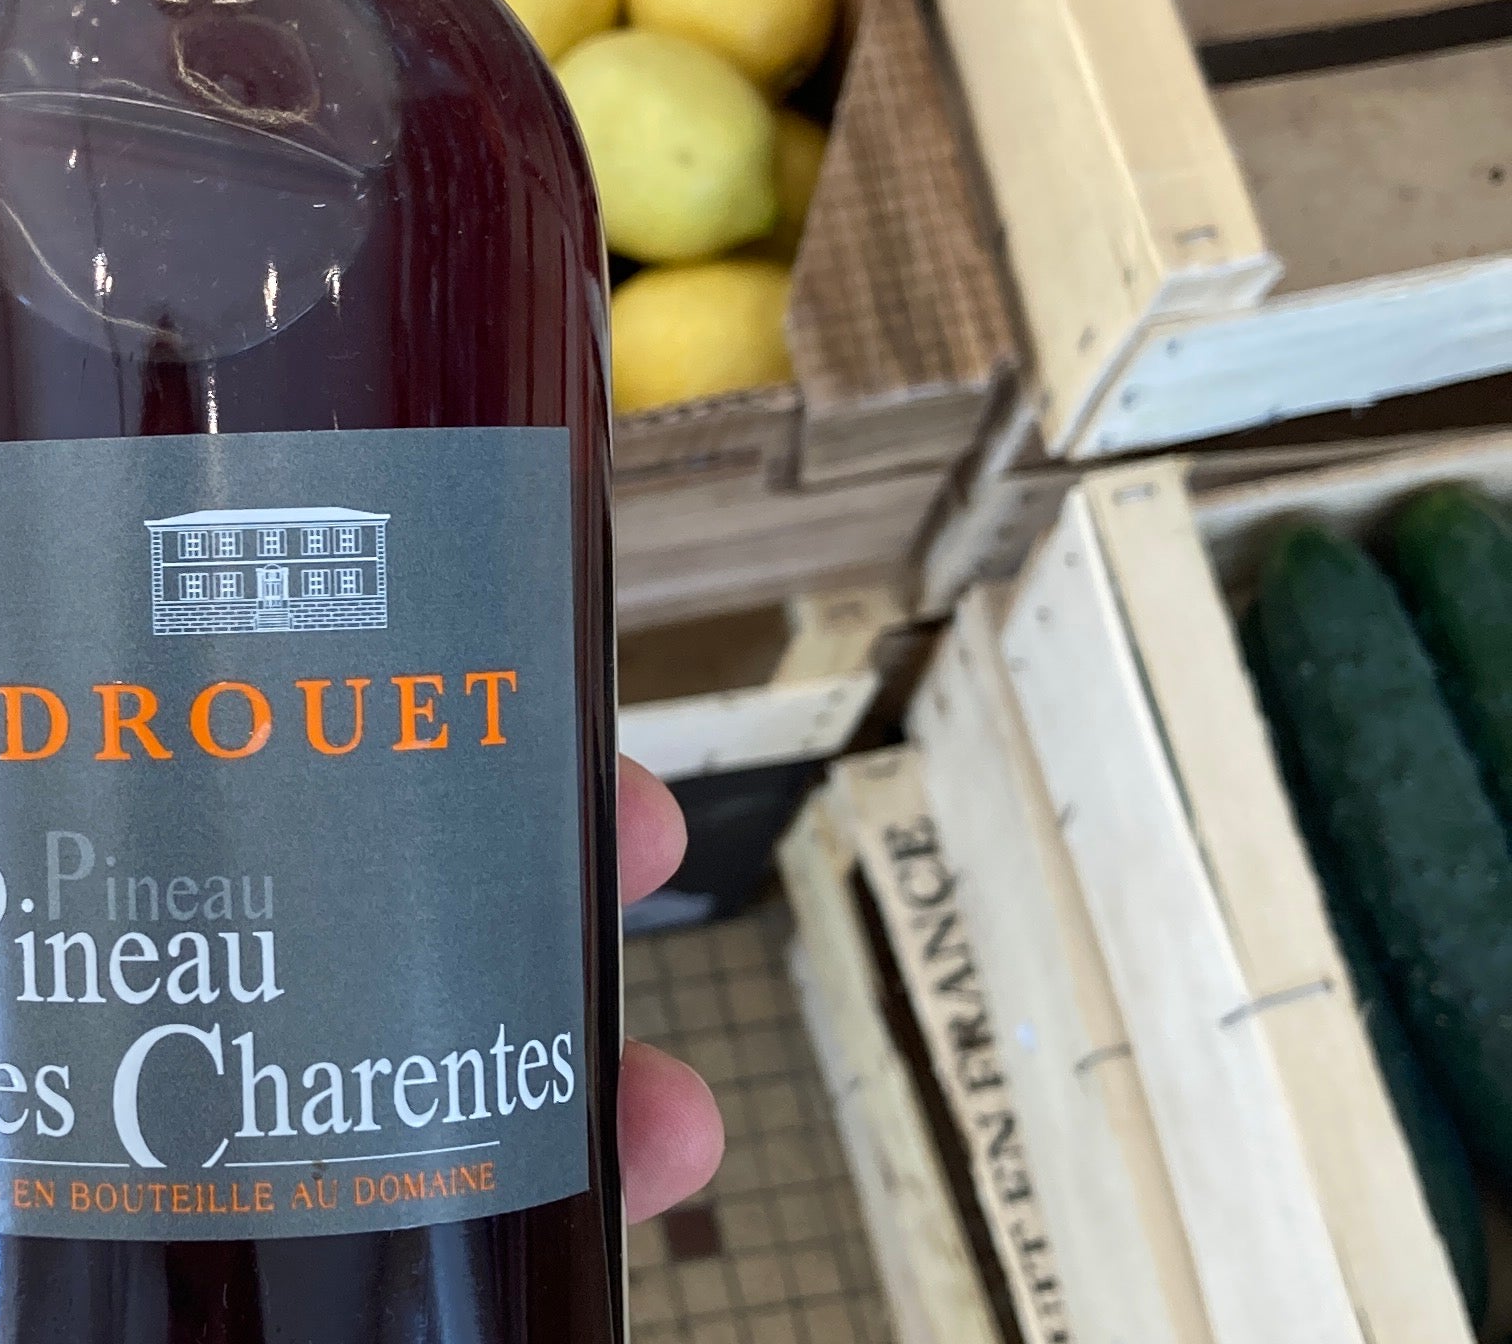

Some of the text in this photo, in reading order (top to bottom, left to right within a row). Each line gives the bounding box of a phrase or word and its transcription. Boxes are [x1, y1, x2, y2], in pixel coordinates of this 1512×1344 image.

[45, 830, 275, 922] Pineau
[112, 1021, 576, 1169] Charentes
[12, 1179, 56, 1210] EN
[71, 1180, 276, 1214] BOUTEILLE
[291, 1179, 338, 1210] AU
[354, 1161, 496, 1206] DOMAINE
